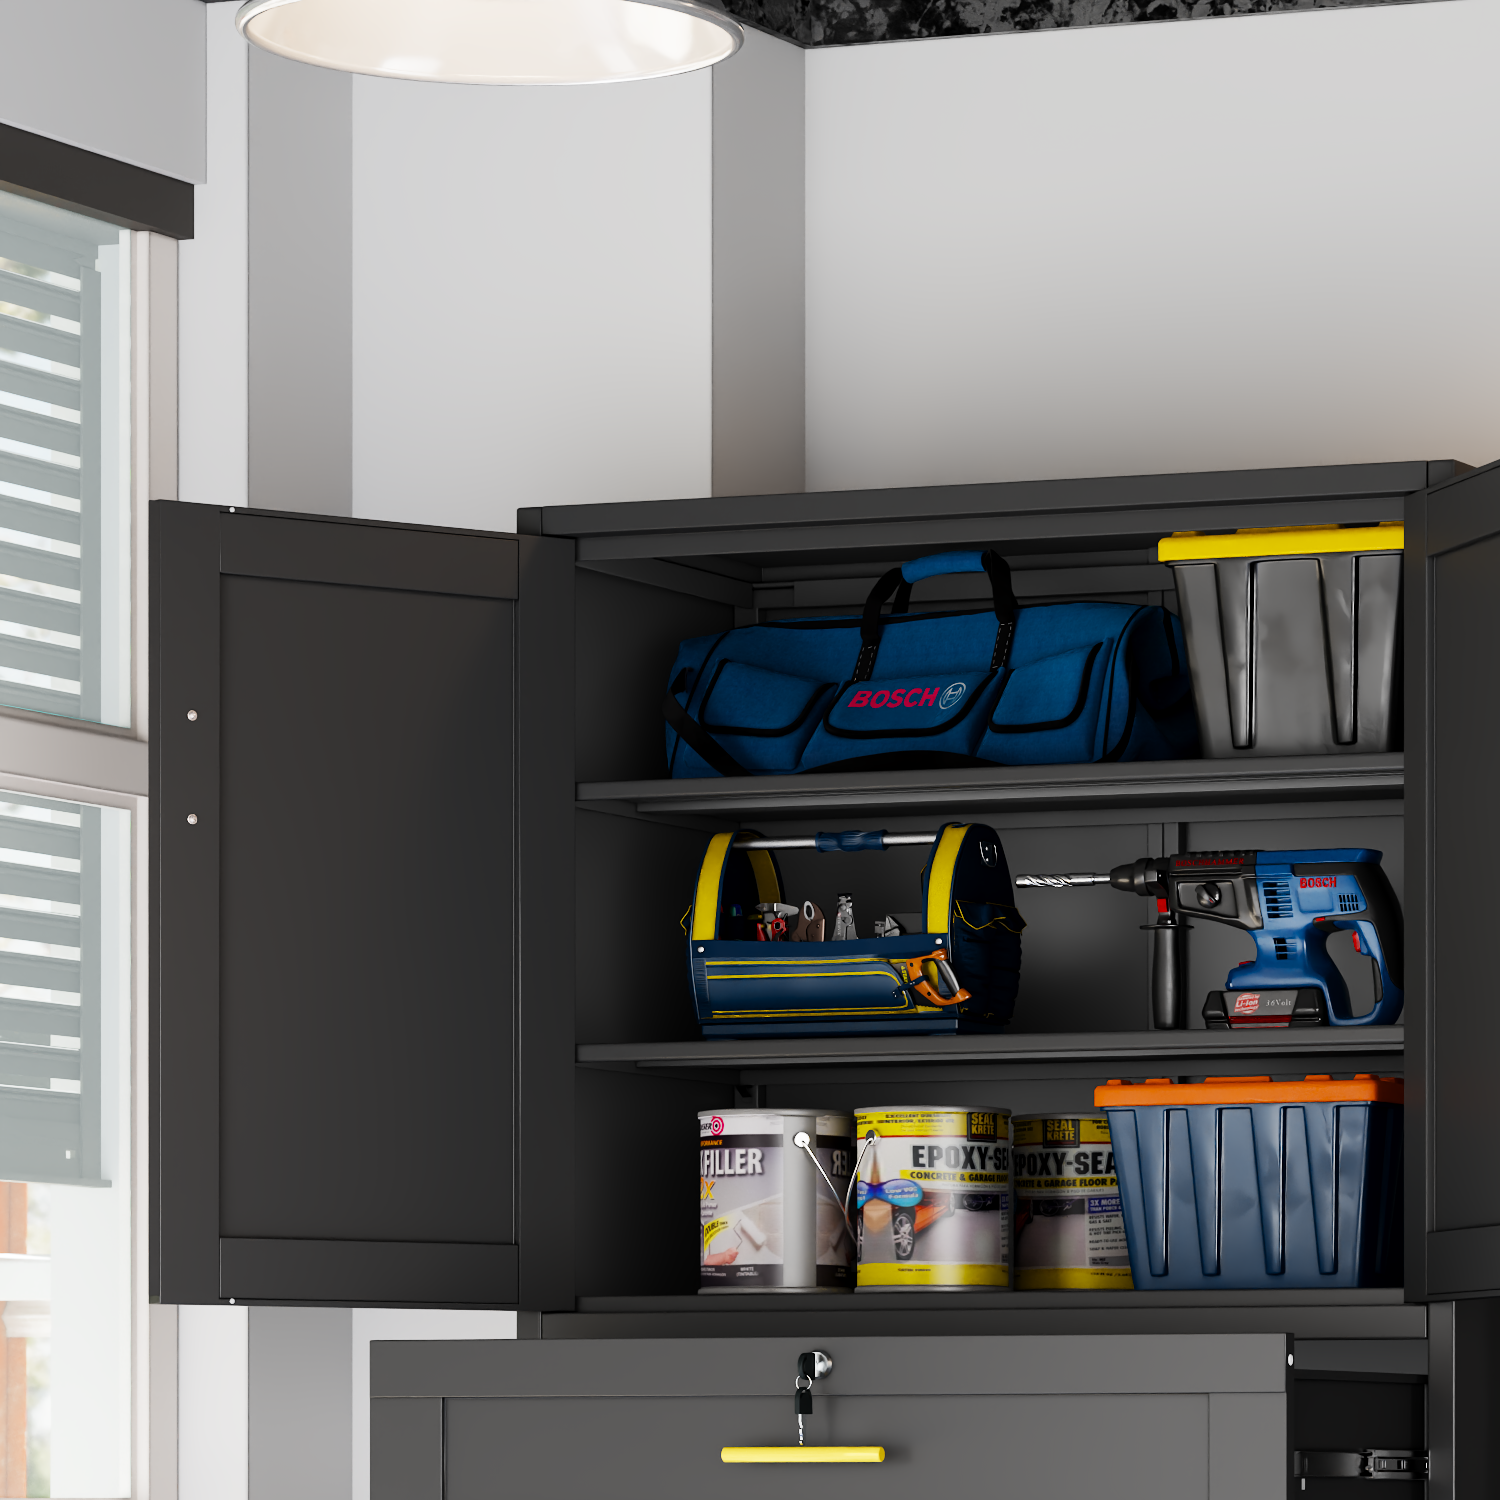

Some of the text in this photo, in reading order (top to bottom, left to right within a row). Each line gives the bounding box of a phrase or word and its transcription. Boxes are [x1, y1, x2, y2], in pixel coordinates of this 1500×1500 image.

[847, 687, 941, 709] BOSCH
[1300, 877, 1336, 888] BOSCH
[971, 1113, 995, 1125] SEAL
[971, 1125, 995, 1136] KRETE
[1046, 1119, 1075, 1131] SEAL
[1046, 1131, 1075, 1141] KRETE
[910, 1171, 957, 1182] CONCRETE
[960, 1173, 966, 1182] &
[968, 1174, 995, 1183] GARAGE
[1036, 1179, 1042, 1188] &
[1044, 1178, 1077, 1188] GARAGE
[1079, 1178, 1107, 1187] FLOOR
[1090, 1198, 1121, 1207] 3X MORE
